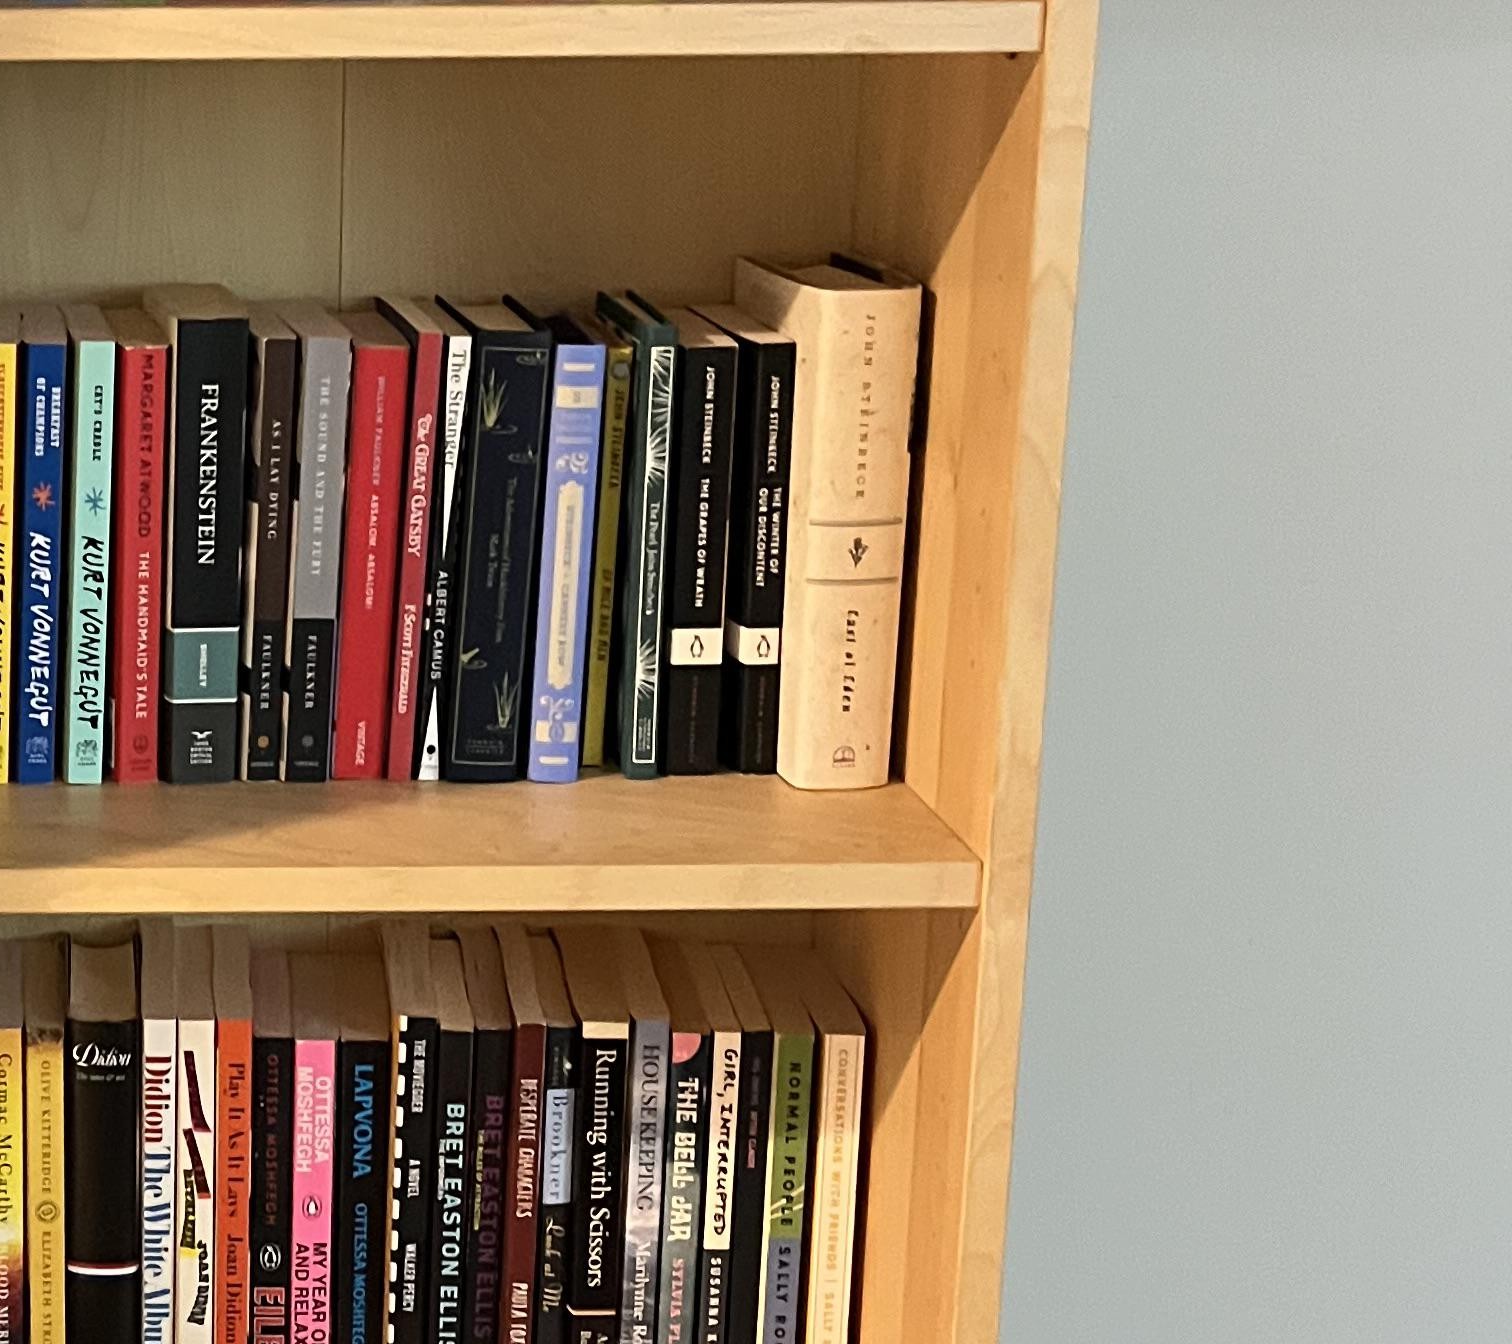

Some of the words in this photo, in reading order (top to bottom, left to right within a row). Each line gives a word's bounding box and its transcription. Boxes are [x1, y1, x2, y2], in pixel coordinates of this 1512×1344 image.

[198, 383, 219, 565] FRANKENSTEIN
[29, 532, 51, 596] KURT
[81, 535, 104, 599] KURT
[138, 552, 150, 578] THE
[434, 570, 448, 626] ALBERT
[136, 584, 150, 679] HANDMAID'S
[431, 630, 445, 679] CAMUS
[26, 604, 52, 727] VONNEGUT
[75, 608, 103, 729] VONNEGUT
[136, 684, 149, 719] TALE
[144, 1055, 172, 1143] Didion
[586, 1048, 616, 1145] Running
[676, 1077, 698, 1123] THE
[717, 1048, 737, 1097] GIRL,
[785, 1062, 802, 1145] NORMAL
[352, 1064, 372, 1178] LAPVONA
[445, 1104, 465, 1168] BRET
[547, 1096, 569, 1202] Brookner
[144, 1146, 172, 1198] The
[590, 1151, 612, 1199] with
[674, 1131, 695, 1188] BELL
[713, 1103, 733, 1236] INTERRUPTED
[780, 1156, 797, 1226] PEOPLE
[144, 1200, 172, 1277] White
[441, 1178, 463, 1276] EASTON
[587, 1207, 610, 1288] Scissors
[668, 1196, 692, 1242] JAR
[294, 1242, 309, 1280] AND
[312, 1242, 327, 1267] MY
[775, 1247, 791, 1302] SALLY
[311, 1272, 327, 1323] YEAR
